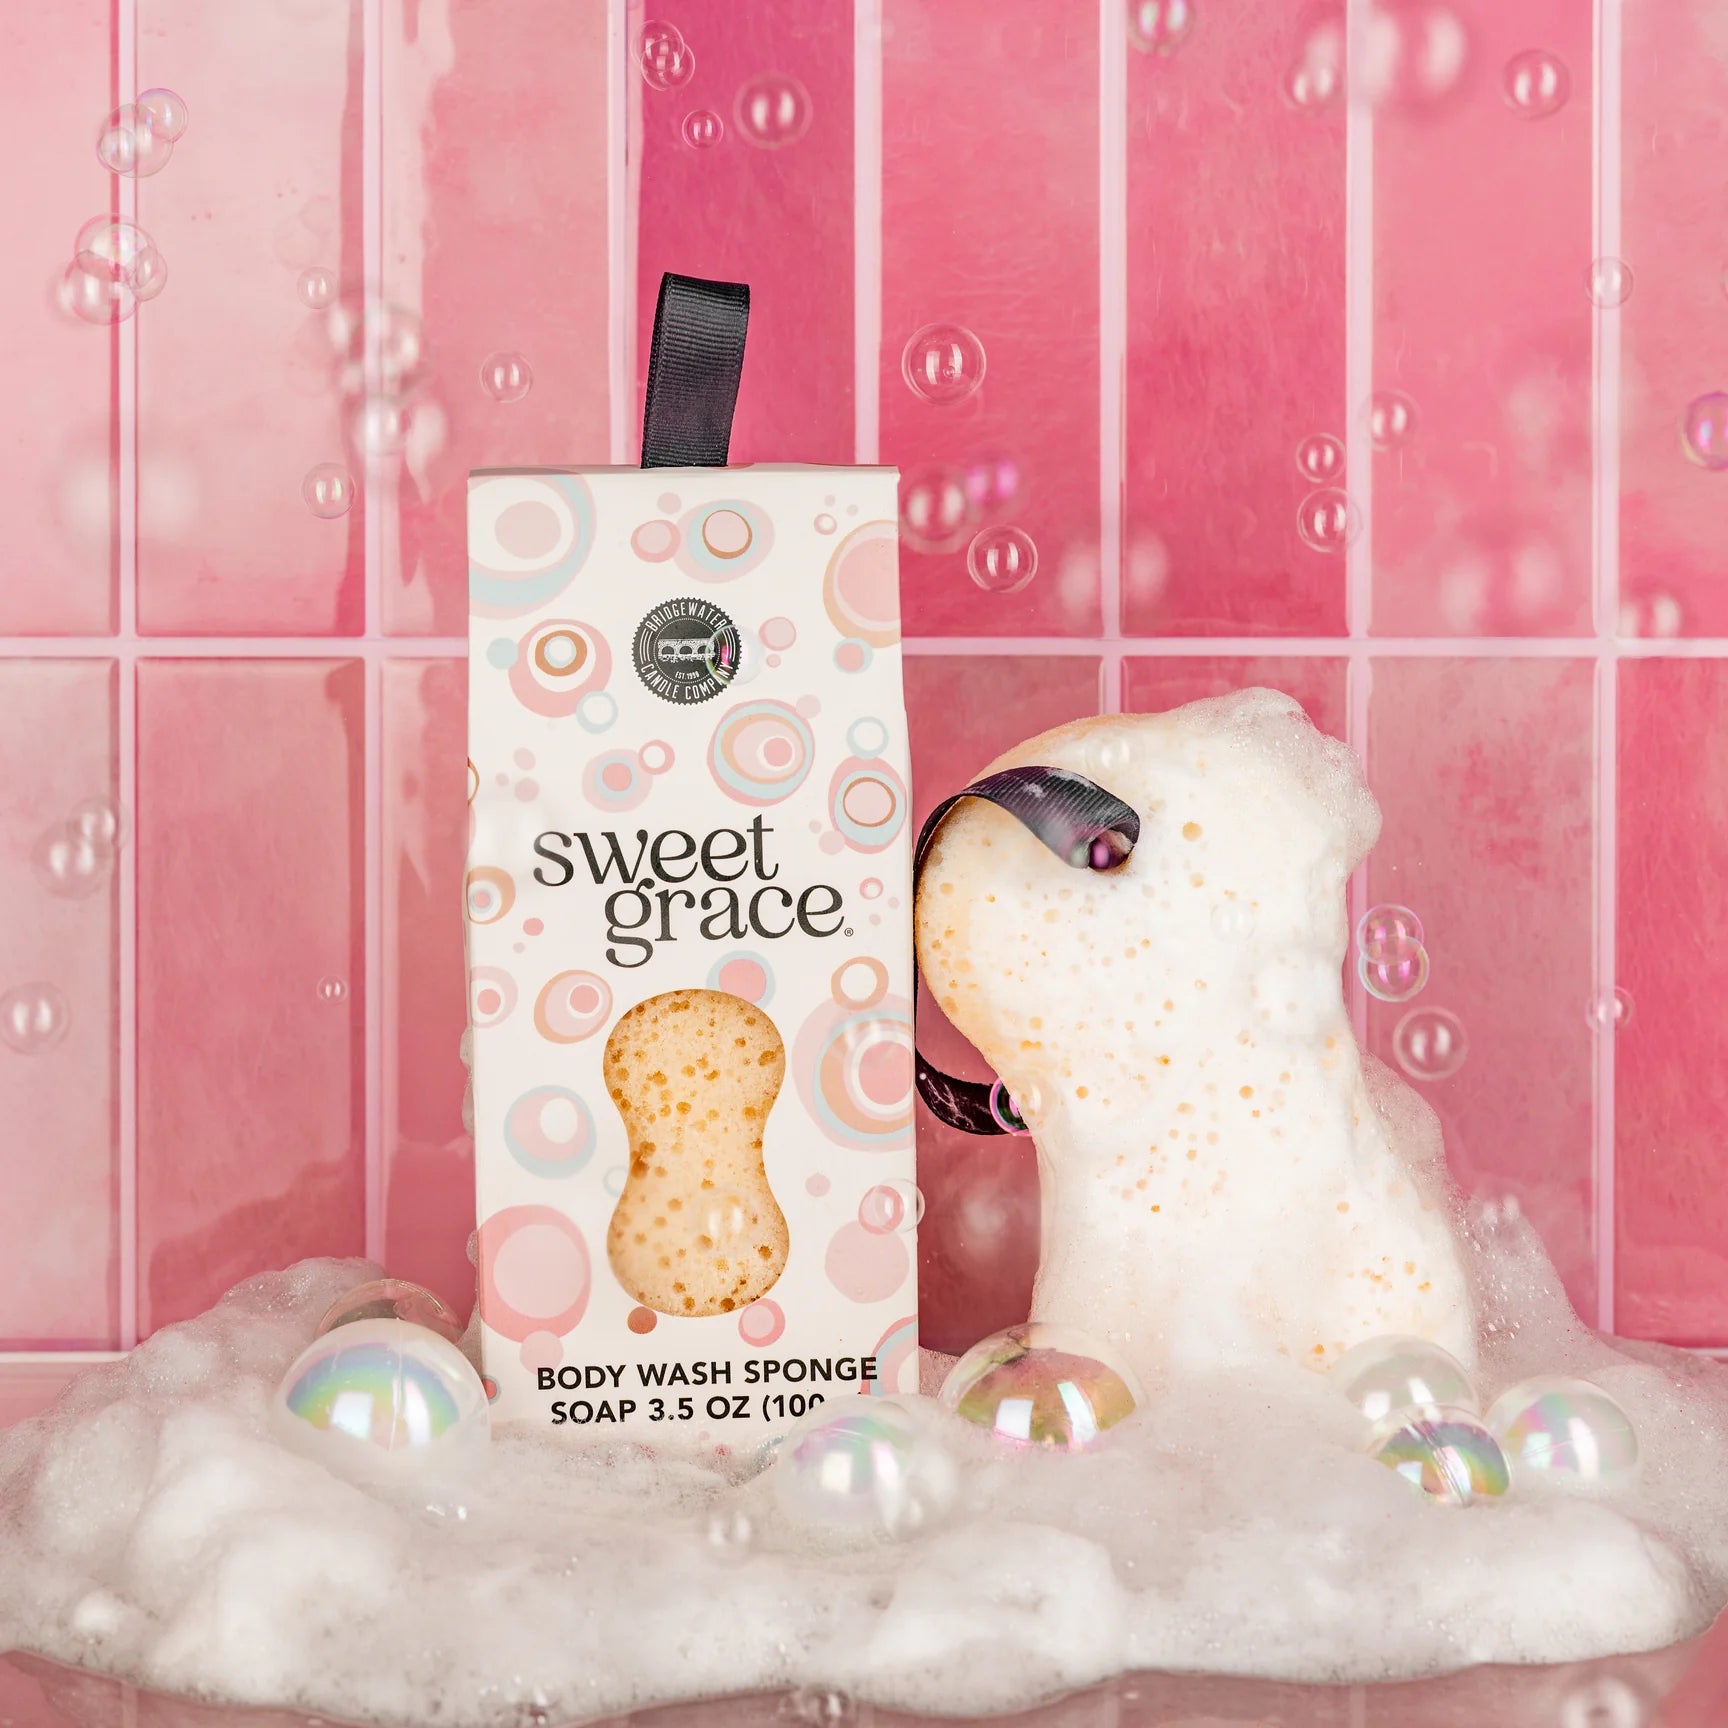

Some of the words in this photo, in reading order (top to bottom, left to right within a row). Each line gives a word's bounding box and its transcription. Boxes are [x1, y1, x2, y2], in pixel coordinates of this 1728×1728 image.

[645, 602, 727, 632] BRIDGEWATER
[641, 664, 680, 699] CANDLE
[533, 814, 779, 887] sweet
[537, 1365, 627, 1390] BODY
[636, 1361, 732, 1387] WASH
[744, 1356, 878, 1384] SPONGE
[551, 1400, 637, 1425] SOAP
[648, 1397, 694, 1421] 3.5
[706, 1395, 751, 1420] OZ
